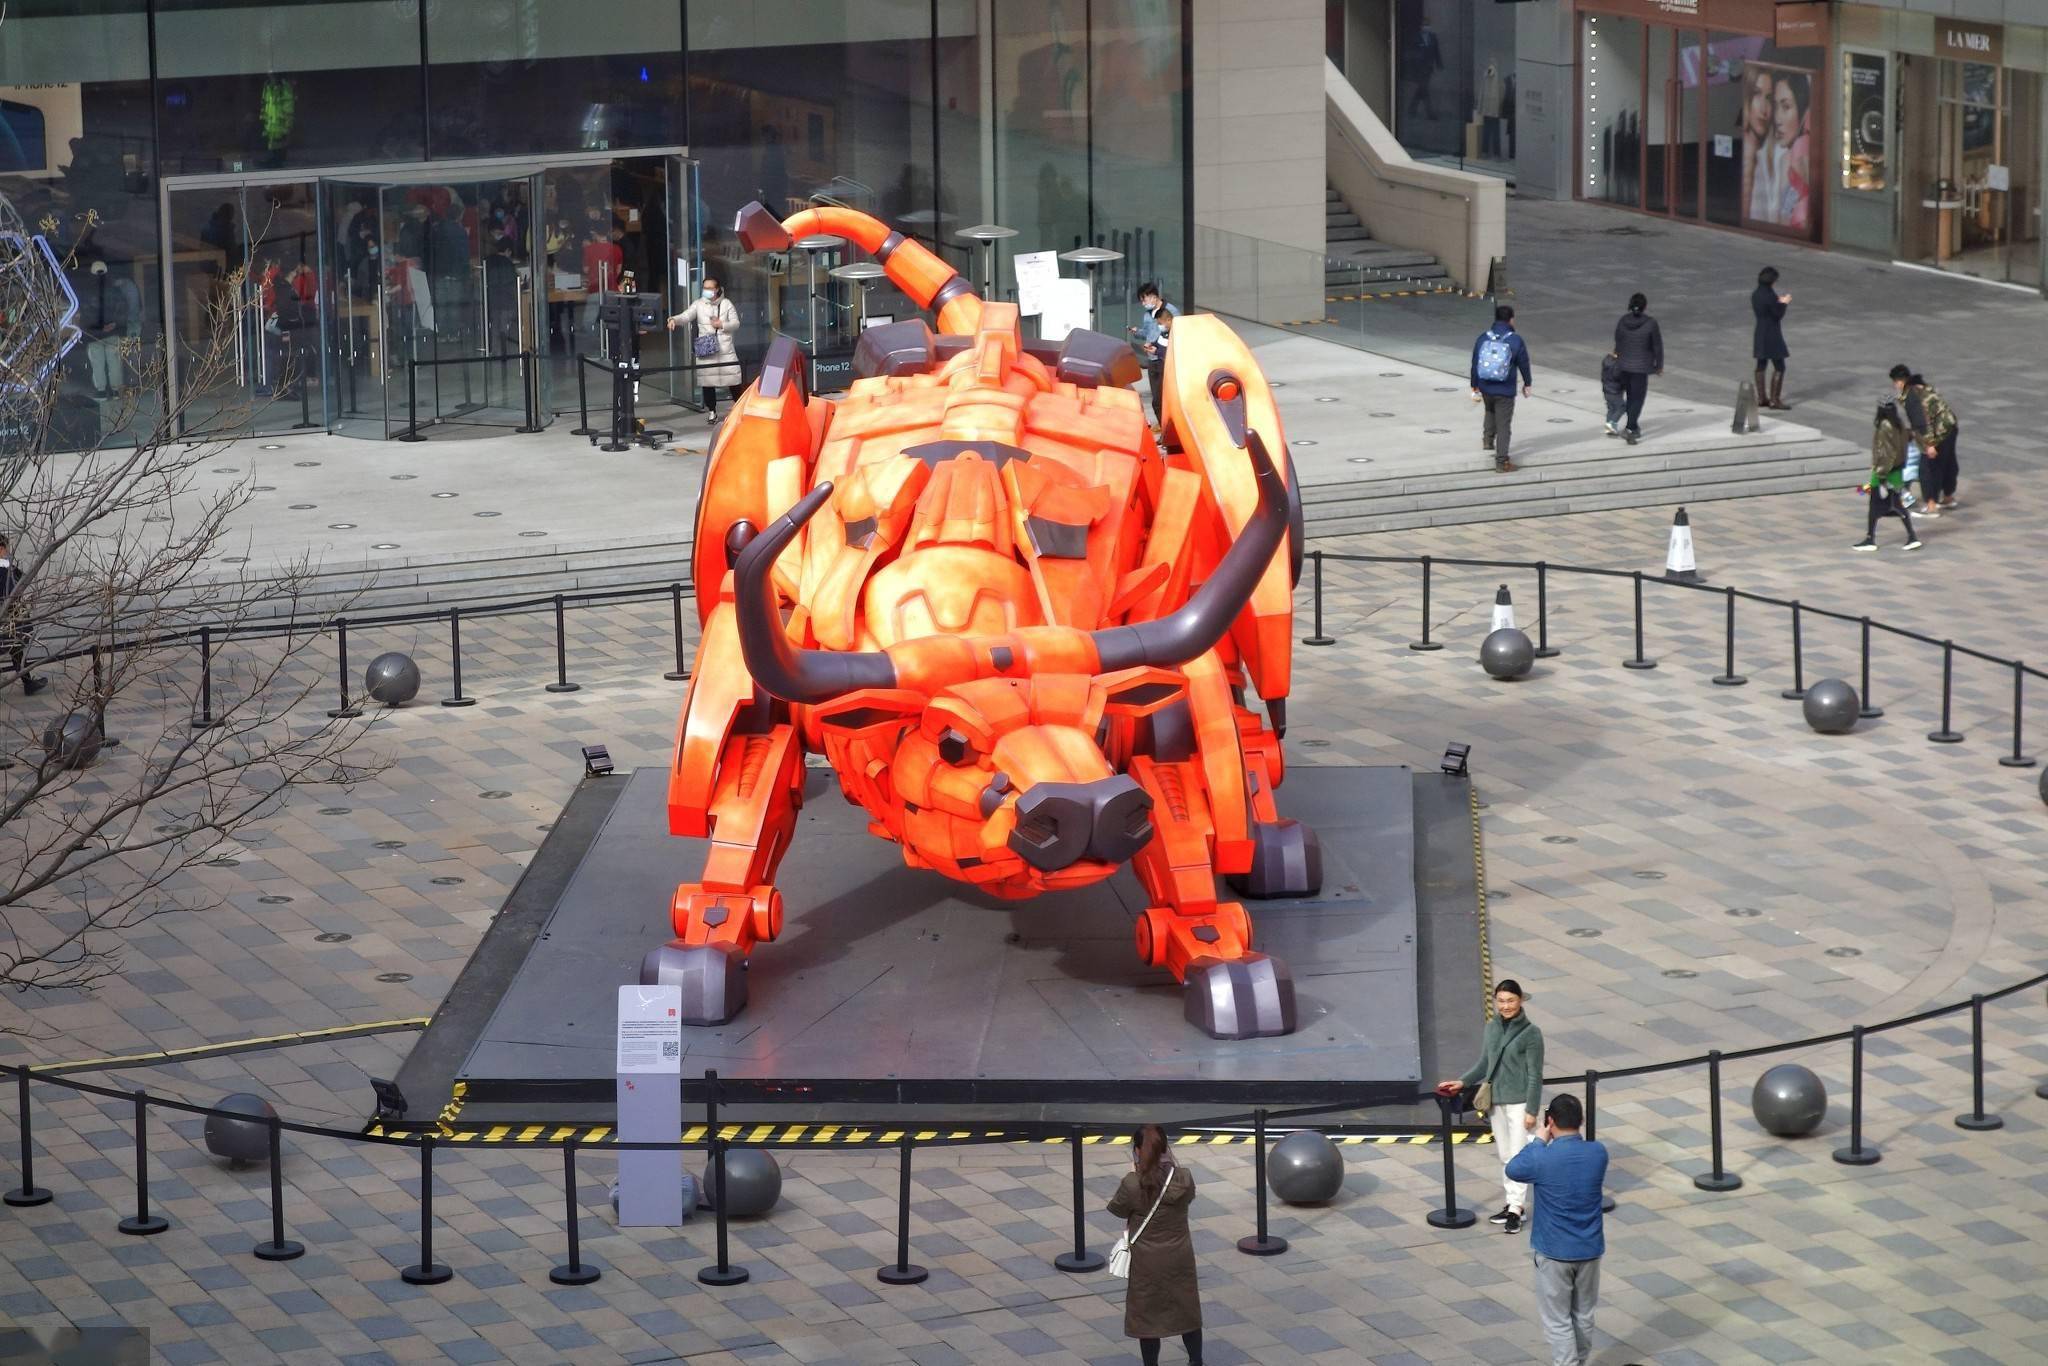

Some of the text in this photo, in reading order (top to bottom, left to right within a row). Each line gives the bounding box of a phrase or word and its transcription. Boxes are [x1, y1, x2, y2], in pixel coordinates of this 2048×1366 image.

[1946, 30, 1990, 51] LA MER
[815, 361, 850, 372] Phone 12
[19, 425, 29, 434] 12
